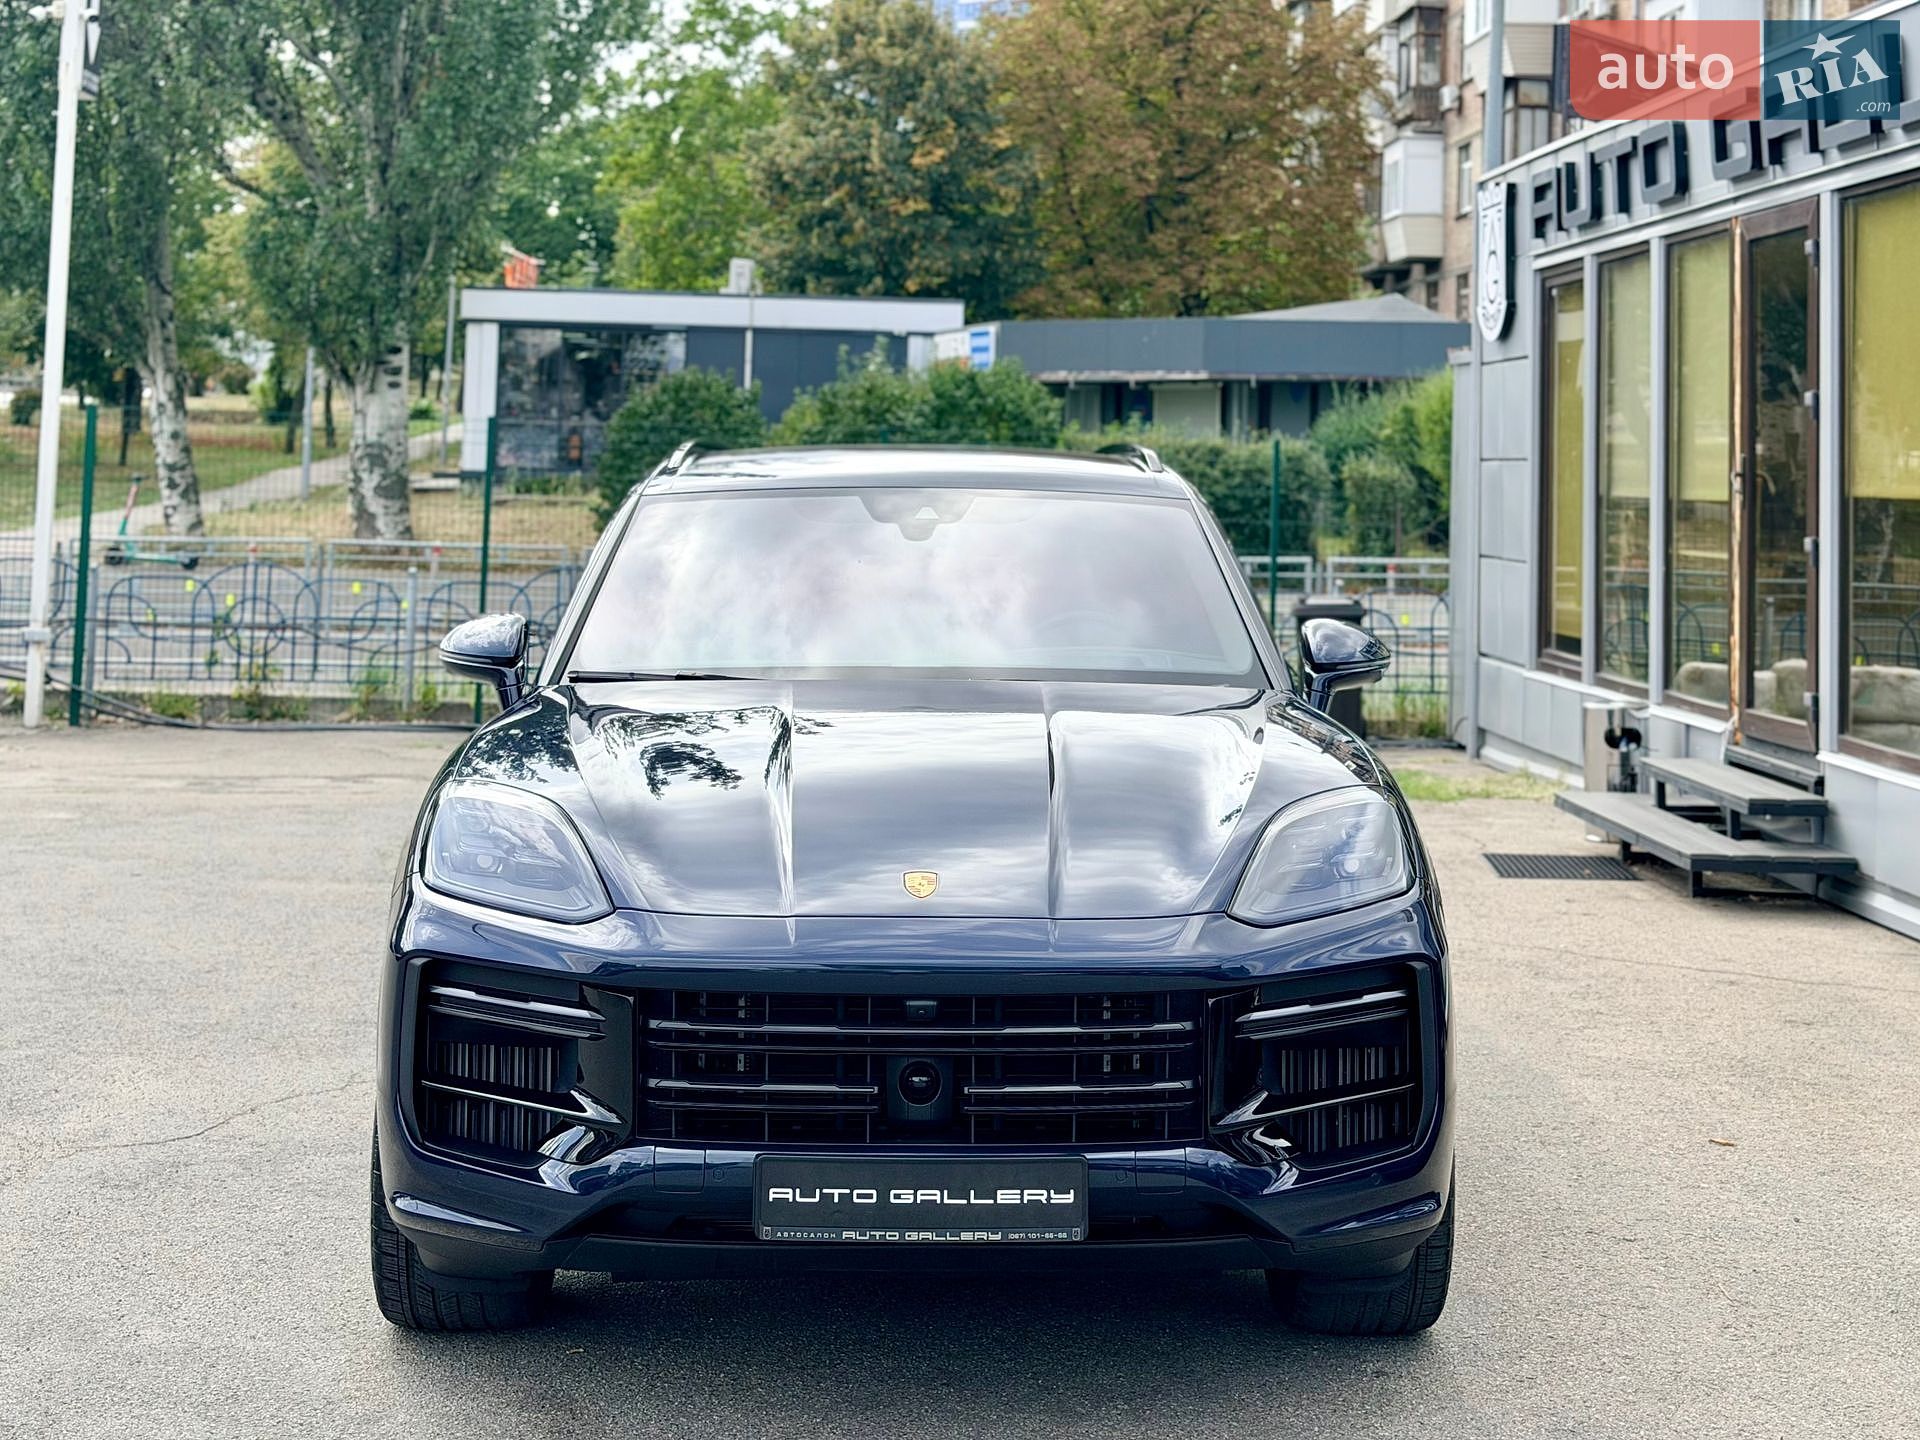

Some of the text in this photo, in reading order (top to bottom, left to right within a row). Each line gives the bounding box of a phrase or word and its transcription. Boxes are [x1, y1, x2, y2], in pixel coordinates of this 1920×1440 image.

[1530, 121, 1688, 240] AUTO
[768, 1187, 1075, 1205] AUTO GALLERY
[776, 1231, 836, 1239] АВТОСАЛОН
[842, 1231, 900, 1240] AUTO
[904, 1231, 1002, 1241] GALLERY
